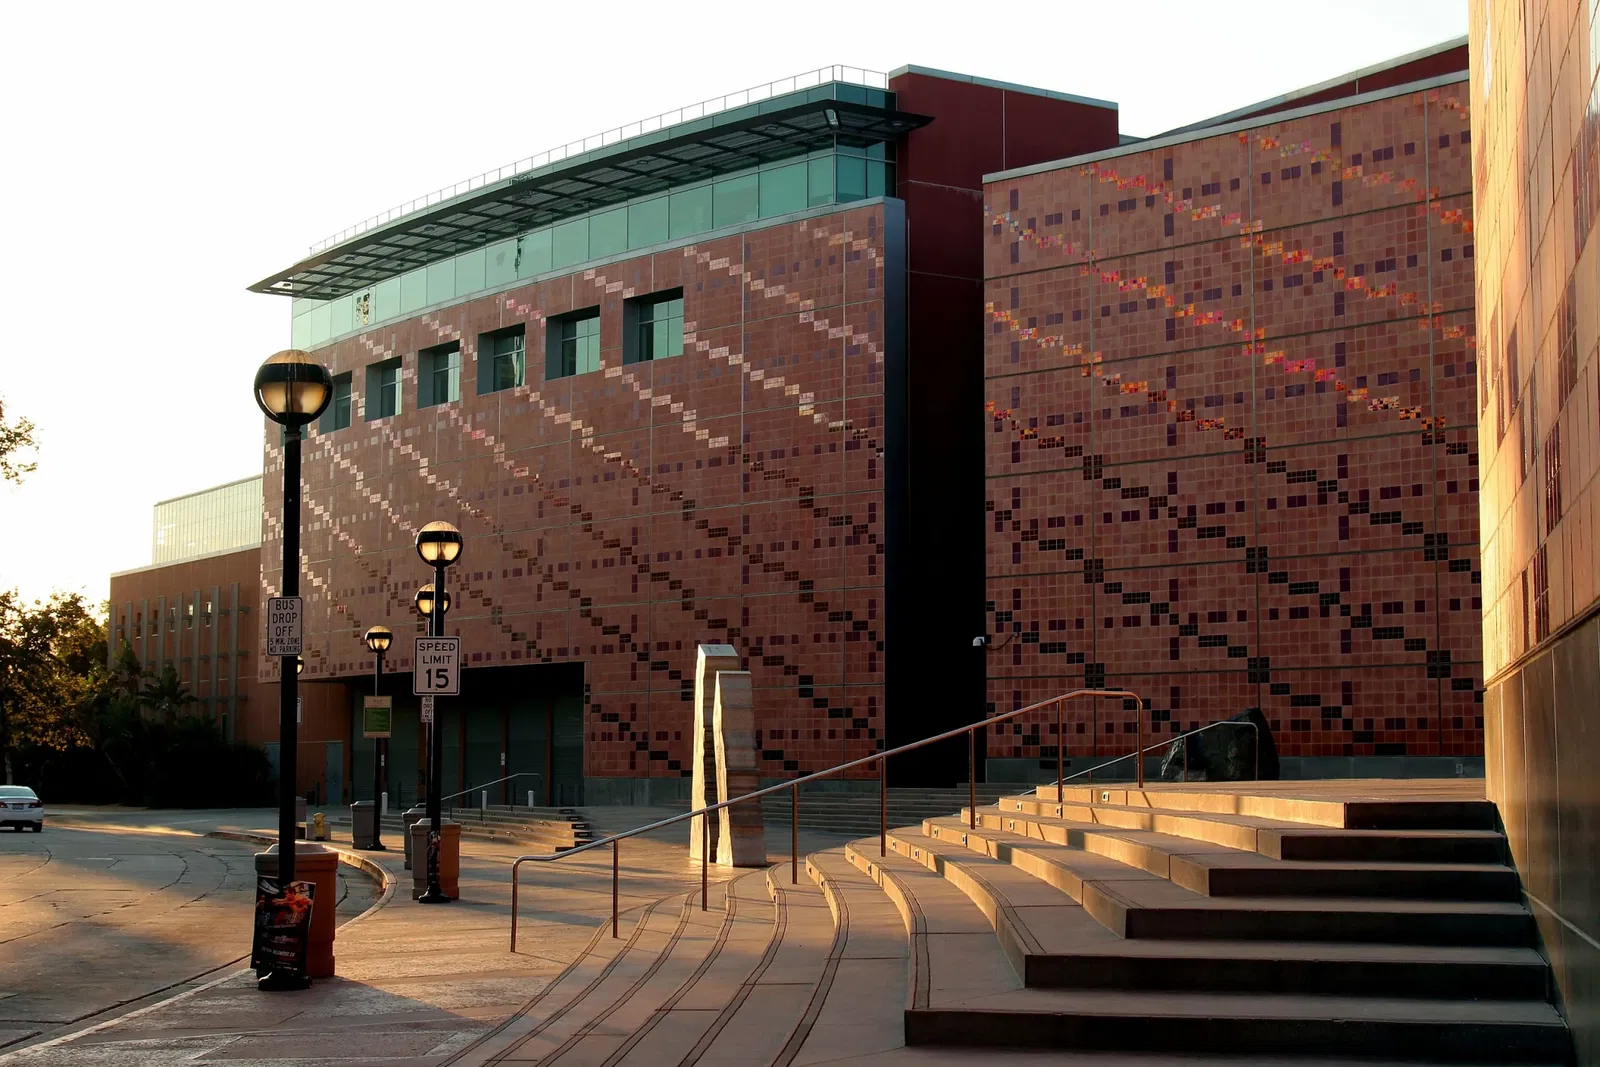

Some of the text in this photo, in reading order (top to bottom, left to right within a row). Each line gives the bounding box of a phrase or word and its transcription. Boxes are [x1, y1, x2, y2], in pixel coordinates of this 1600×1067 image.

[275, 600, 295, 611] BUS
[272, 612, 298, 624] DROP
[275, 626, 294, 637] OFF
[269, 645, 277, 654] NO
[419, 642, 456, 652] SPEED
[422, 655, 453, 665] LIMIT
[425, 668, 450, 689] 15
